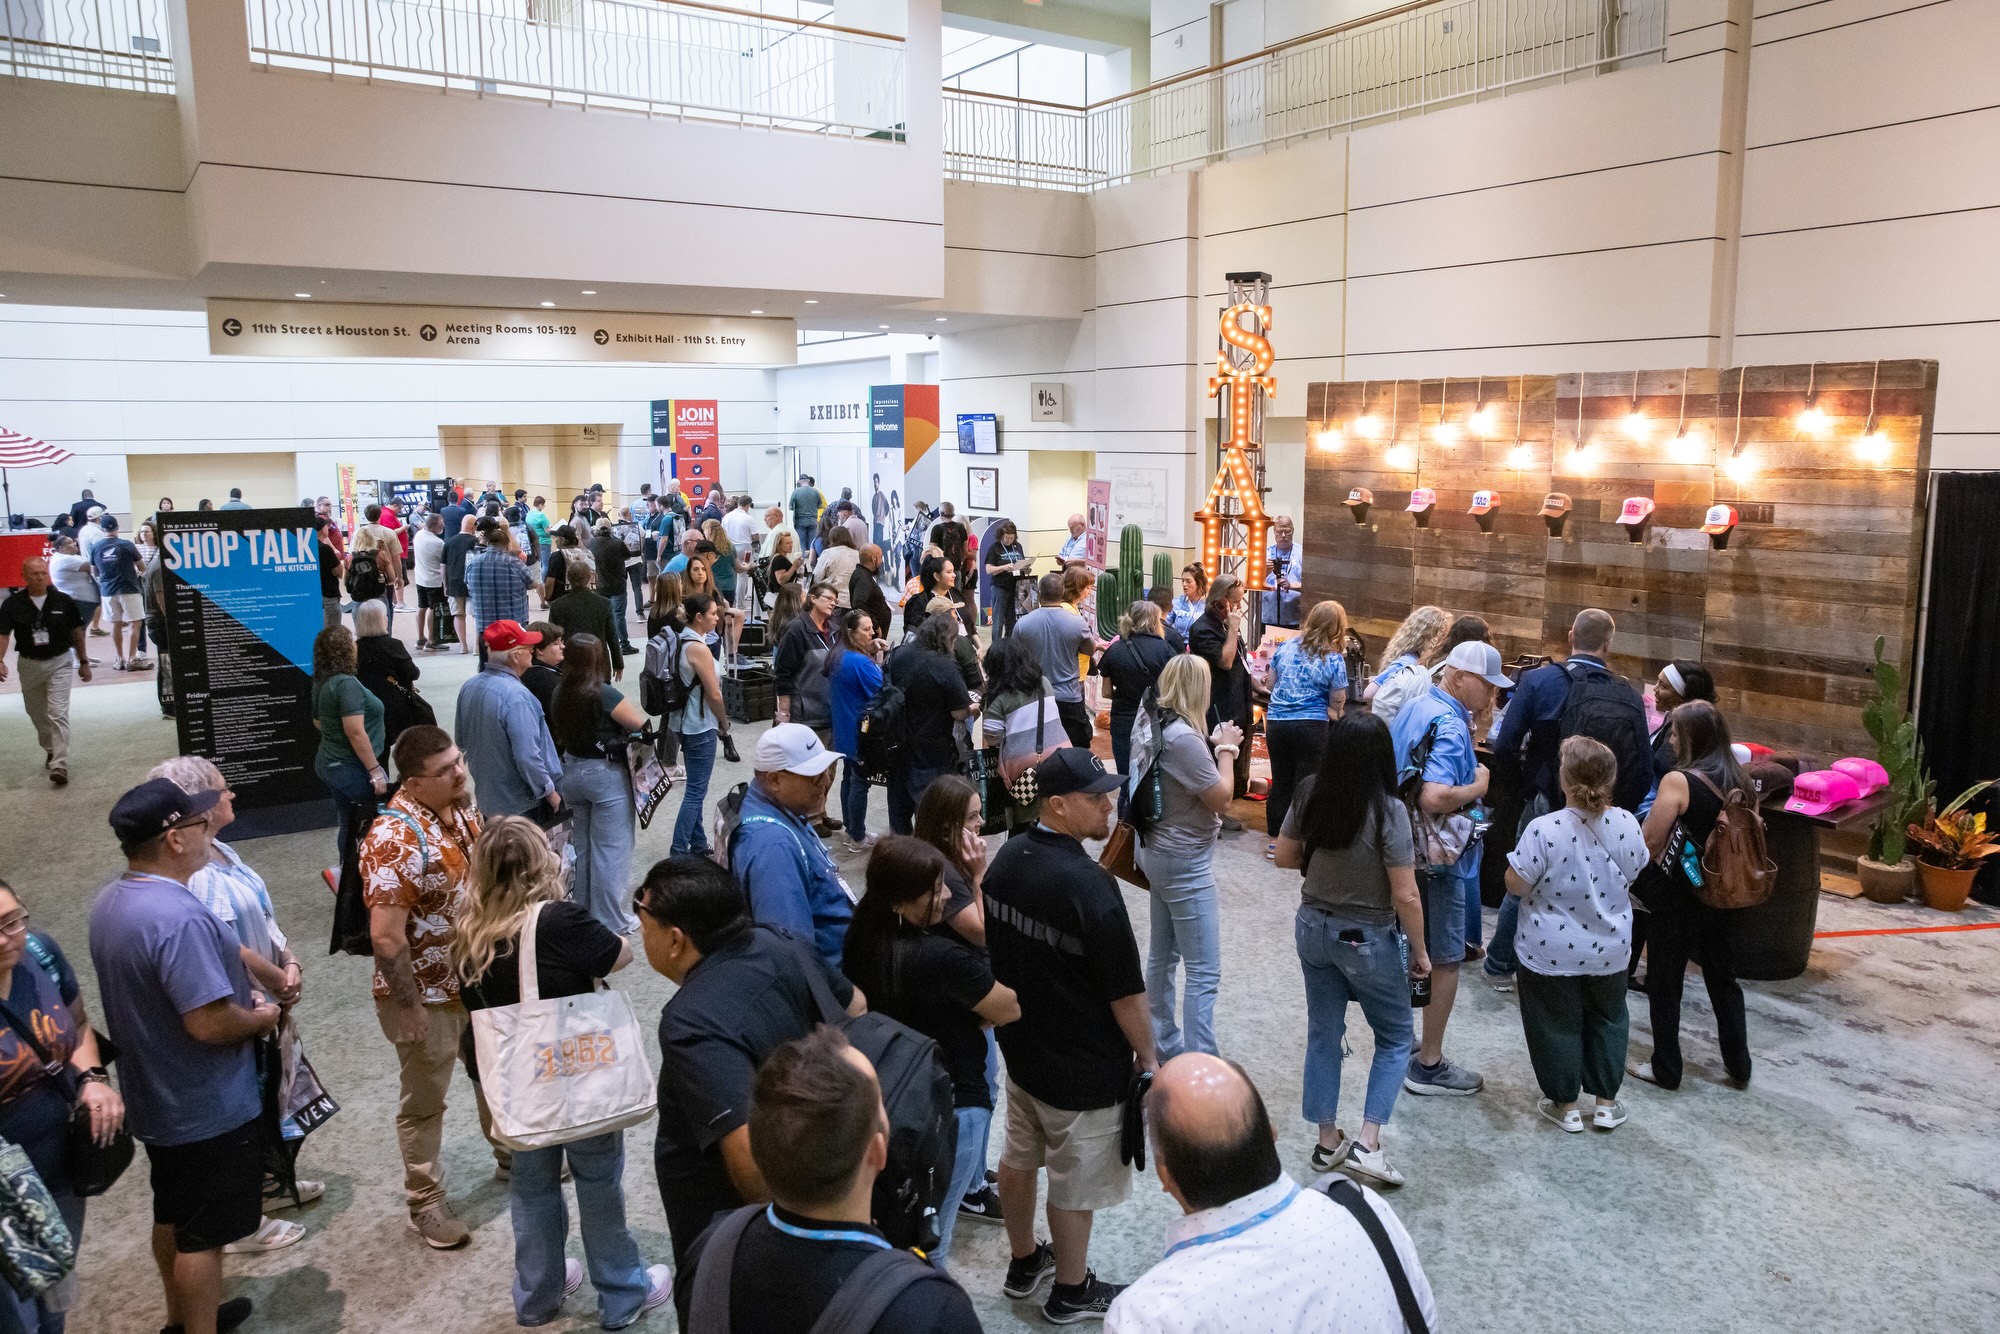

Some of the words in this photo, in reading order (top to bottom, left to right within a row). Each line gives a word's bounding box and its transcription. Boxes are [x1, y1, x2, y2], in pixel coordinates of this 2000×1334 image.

[252, 323, 277, 334] 11th
[281, 324, 322, 335] Street
[335, 325, 389, 337] Houston
[393, 326, 411, 337] St.
[446, 324, 493, 335] Meeting
[496, 324, 533, 334] Rooms
[536, 326, 577, 336] 105-122
[446, 335, 480, 344] Arena
[616, 333, 653, 344] Exhibit
[655, 334, 674, 344] Hall
[683, 335, 702, 344] 11th
[705, 336, 718, 345] St.
[720, 336, 746, 346] Entry
[677, 408, 714, 420] JOIN
[810, 404, 860, 420] EXHIBIT
[874, 422, 898, 432] welcome
[163, 530, 239, 570] SHOP
[243, 528, 317, 566] TALK
[288, 564, 318, 572] KITCHEN
[648, 777, 670, 806] SEVEN
[1796, 786, 1821, 802] TEXAS
[1662, 826, 1683, 875] SEVEN
[541, 1035, 616, 1080] 1962
[298, 1098, 334, 1127] VEN
